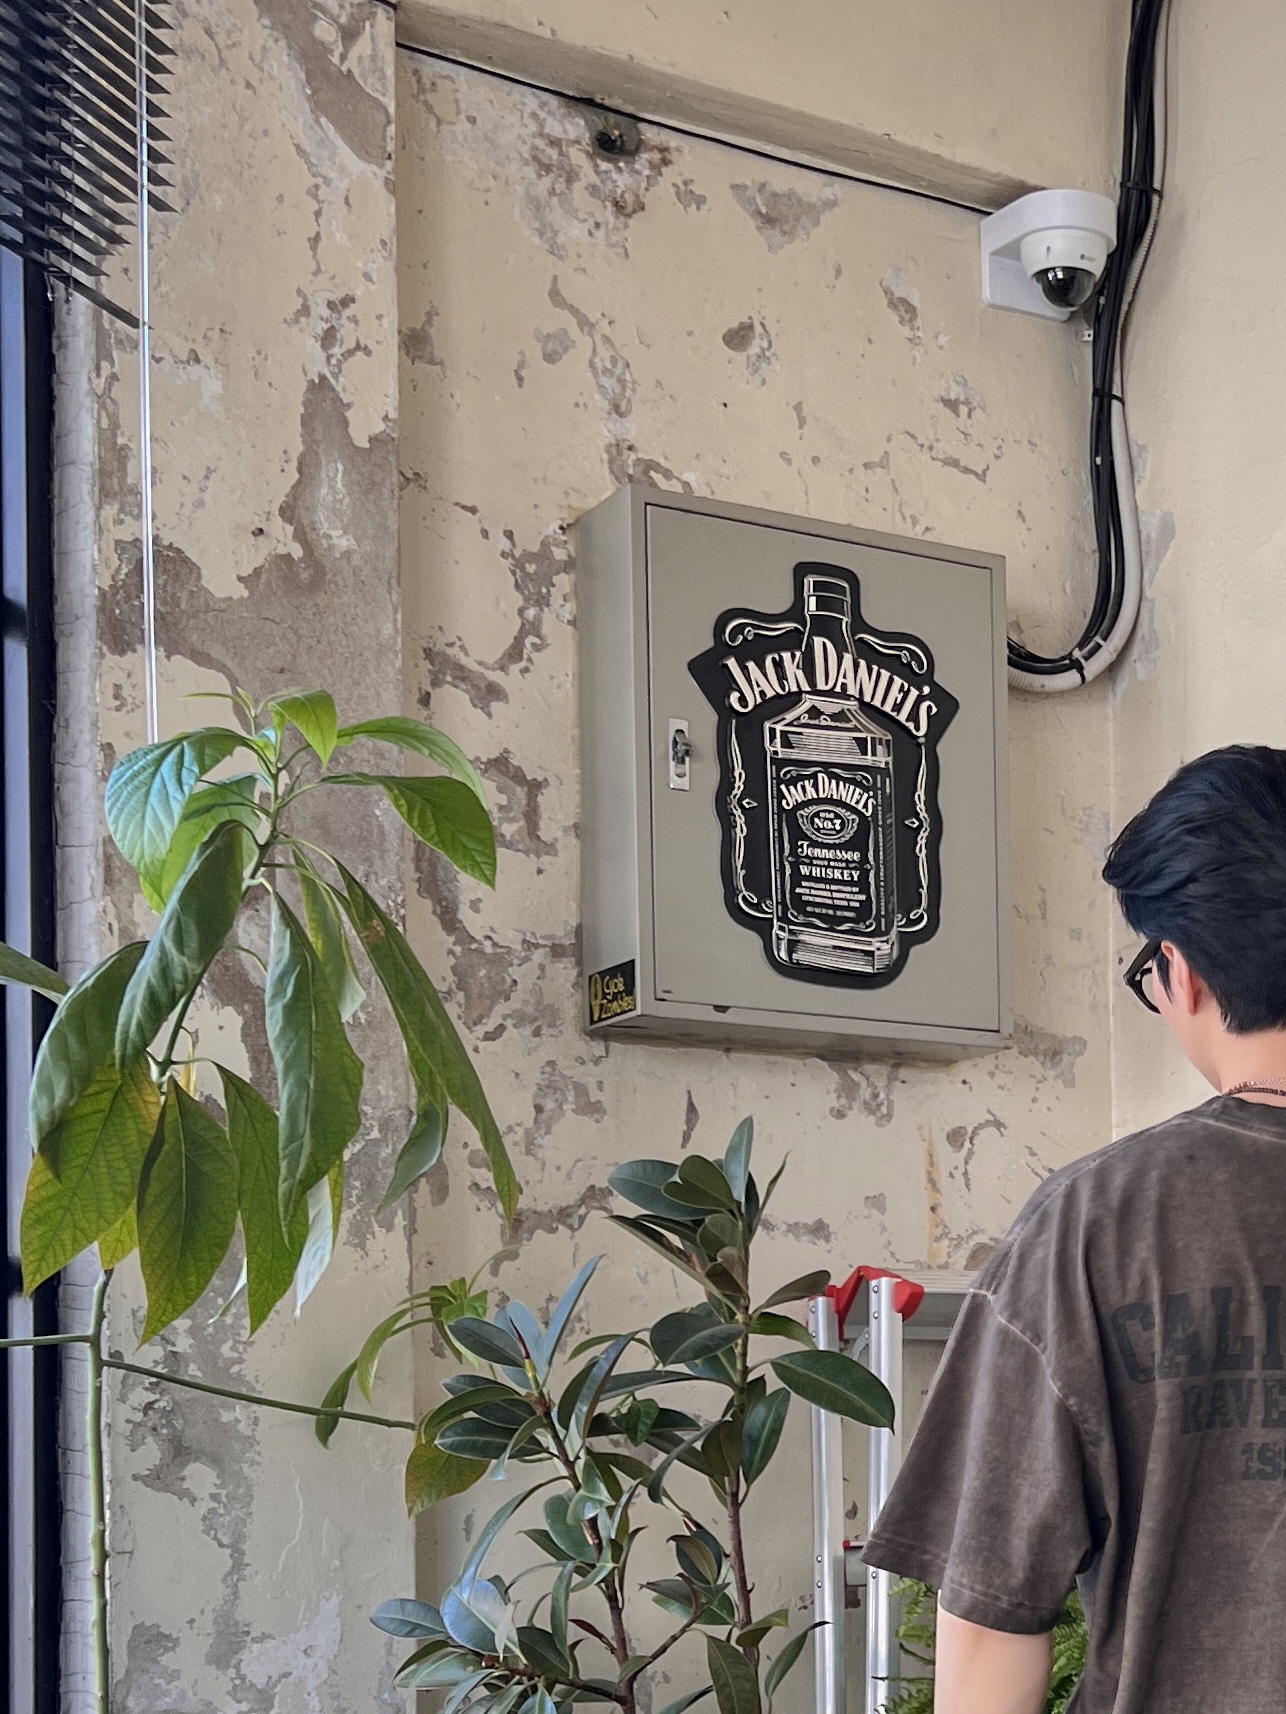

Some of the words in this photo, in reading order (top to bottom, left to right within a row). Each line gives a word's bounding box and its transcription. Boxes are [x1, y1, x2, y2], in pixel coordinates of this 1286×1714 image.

[724, 650, 811, 713] JACK
[812, 635, 938, 738] DANIEL'S
[780, 778, 818, 810] JACK
[817, 772, 877, 818] DANIEL'S
[797, 840, 861, 862] Tennessee
[799, 864, 861, 882] WHISKEY
